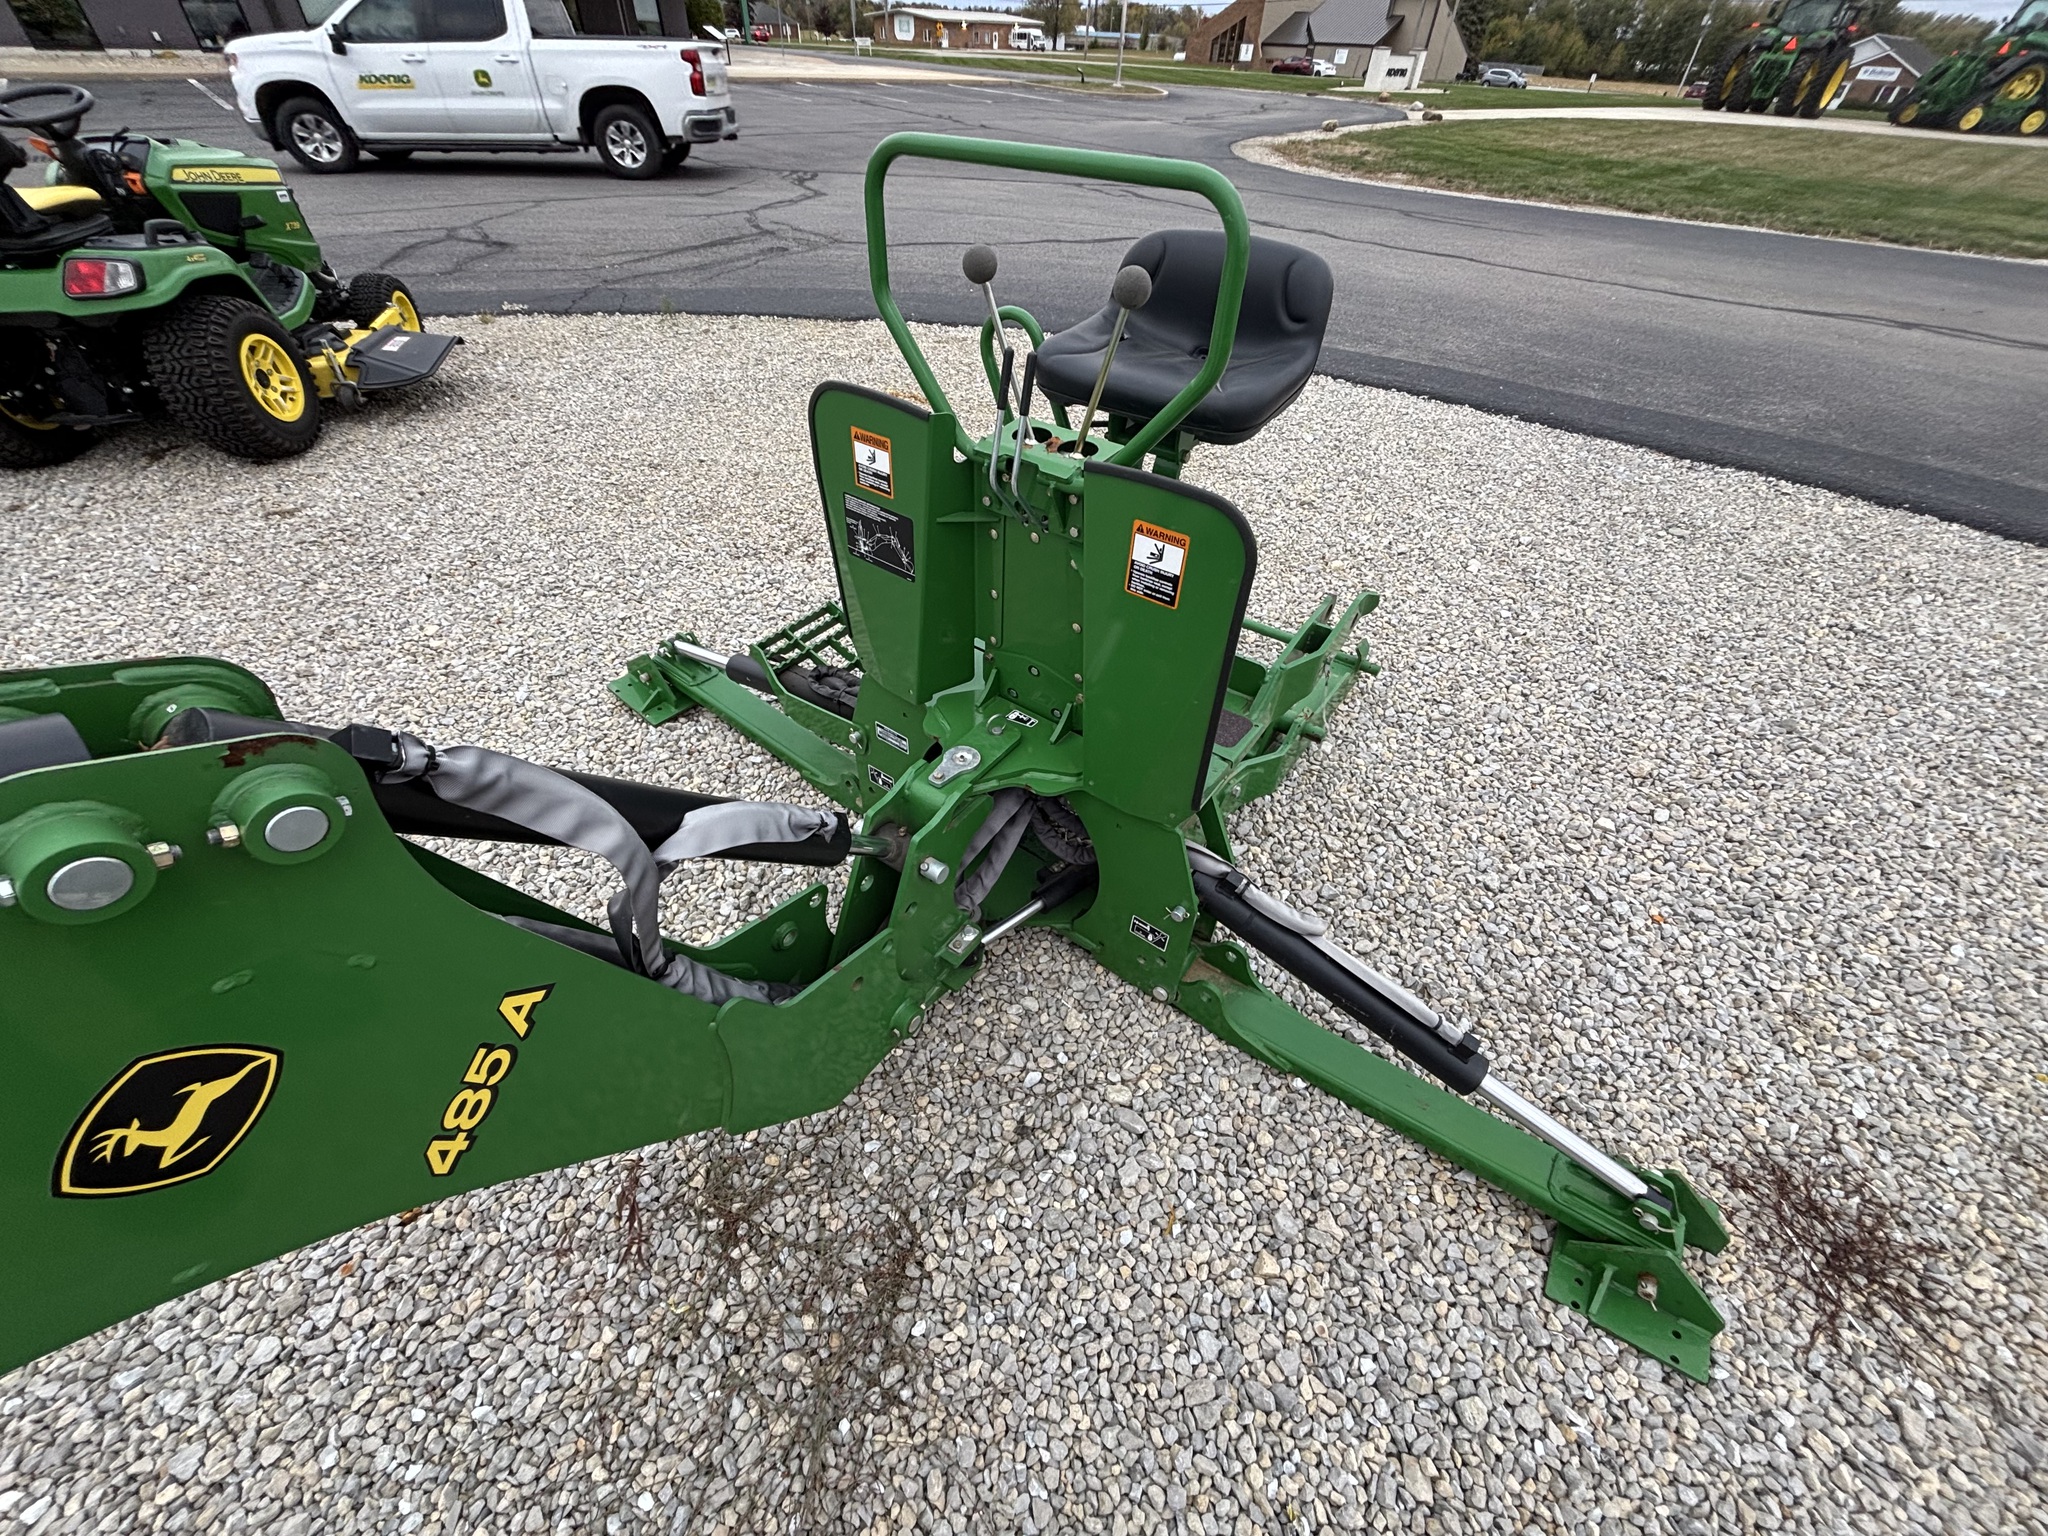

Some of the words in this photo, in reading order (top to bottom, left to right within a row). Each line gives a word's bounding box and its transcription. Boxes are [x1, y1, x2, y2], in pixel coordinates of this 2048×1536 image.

[182, 169, 212, 181] JOHN
[209, 170, 244, 181] DEERE
[860, 433, 889, 450] WARNING
[1145, 526, 1186, 547] WARNING
[425, 1045, 515, 1176] 485
